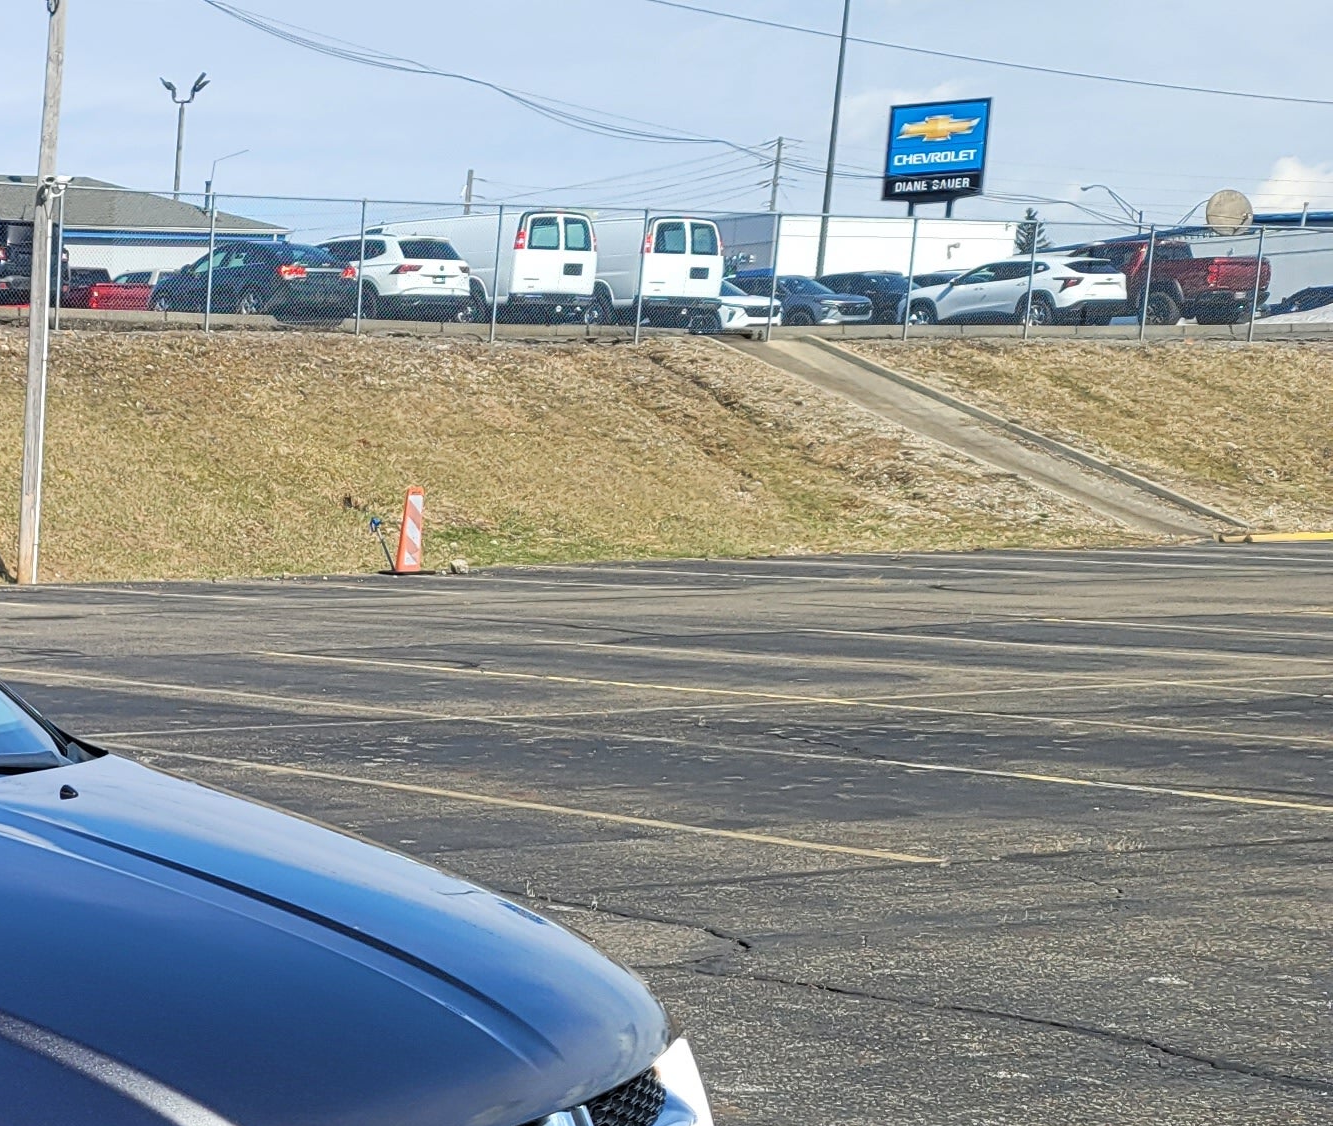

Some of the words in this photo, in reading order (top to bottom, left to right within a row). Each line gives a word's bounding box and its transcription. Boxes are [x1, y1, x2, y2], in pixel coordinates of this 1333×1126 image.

[893, 149, 978, 166] CHEVROLET
[894, 179, 928, 193] DIANE
[931, 177, 971, 190] SAUER
